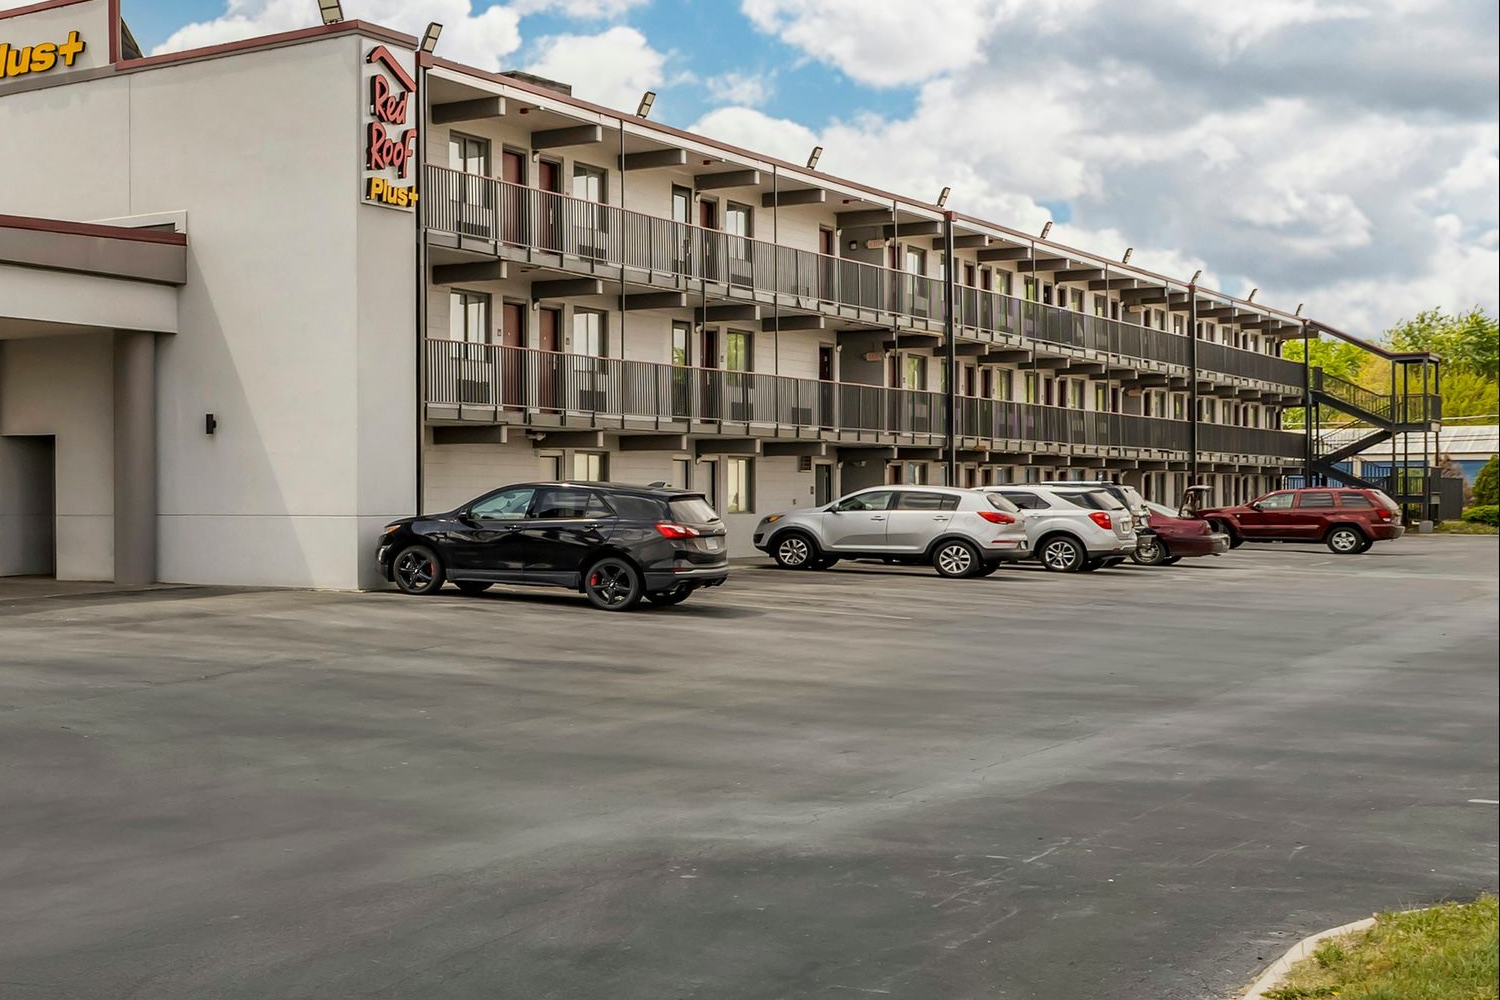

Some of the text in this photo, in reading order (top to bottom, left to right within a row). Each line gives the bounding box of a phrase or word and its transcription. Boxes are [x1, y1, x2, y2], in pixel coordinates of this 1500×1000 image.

[371, 74, 409, 124] Red
[367, 121, 417, 179] Roof
[367, 177, 418, 208] Plus+
